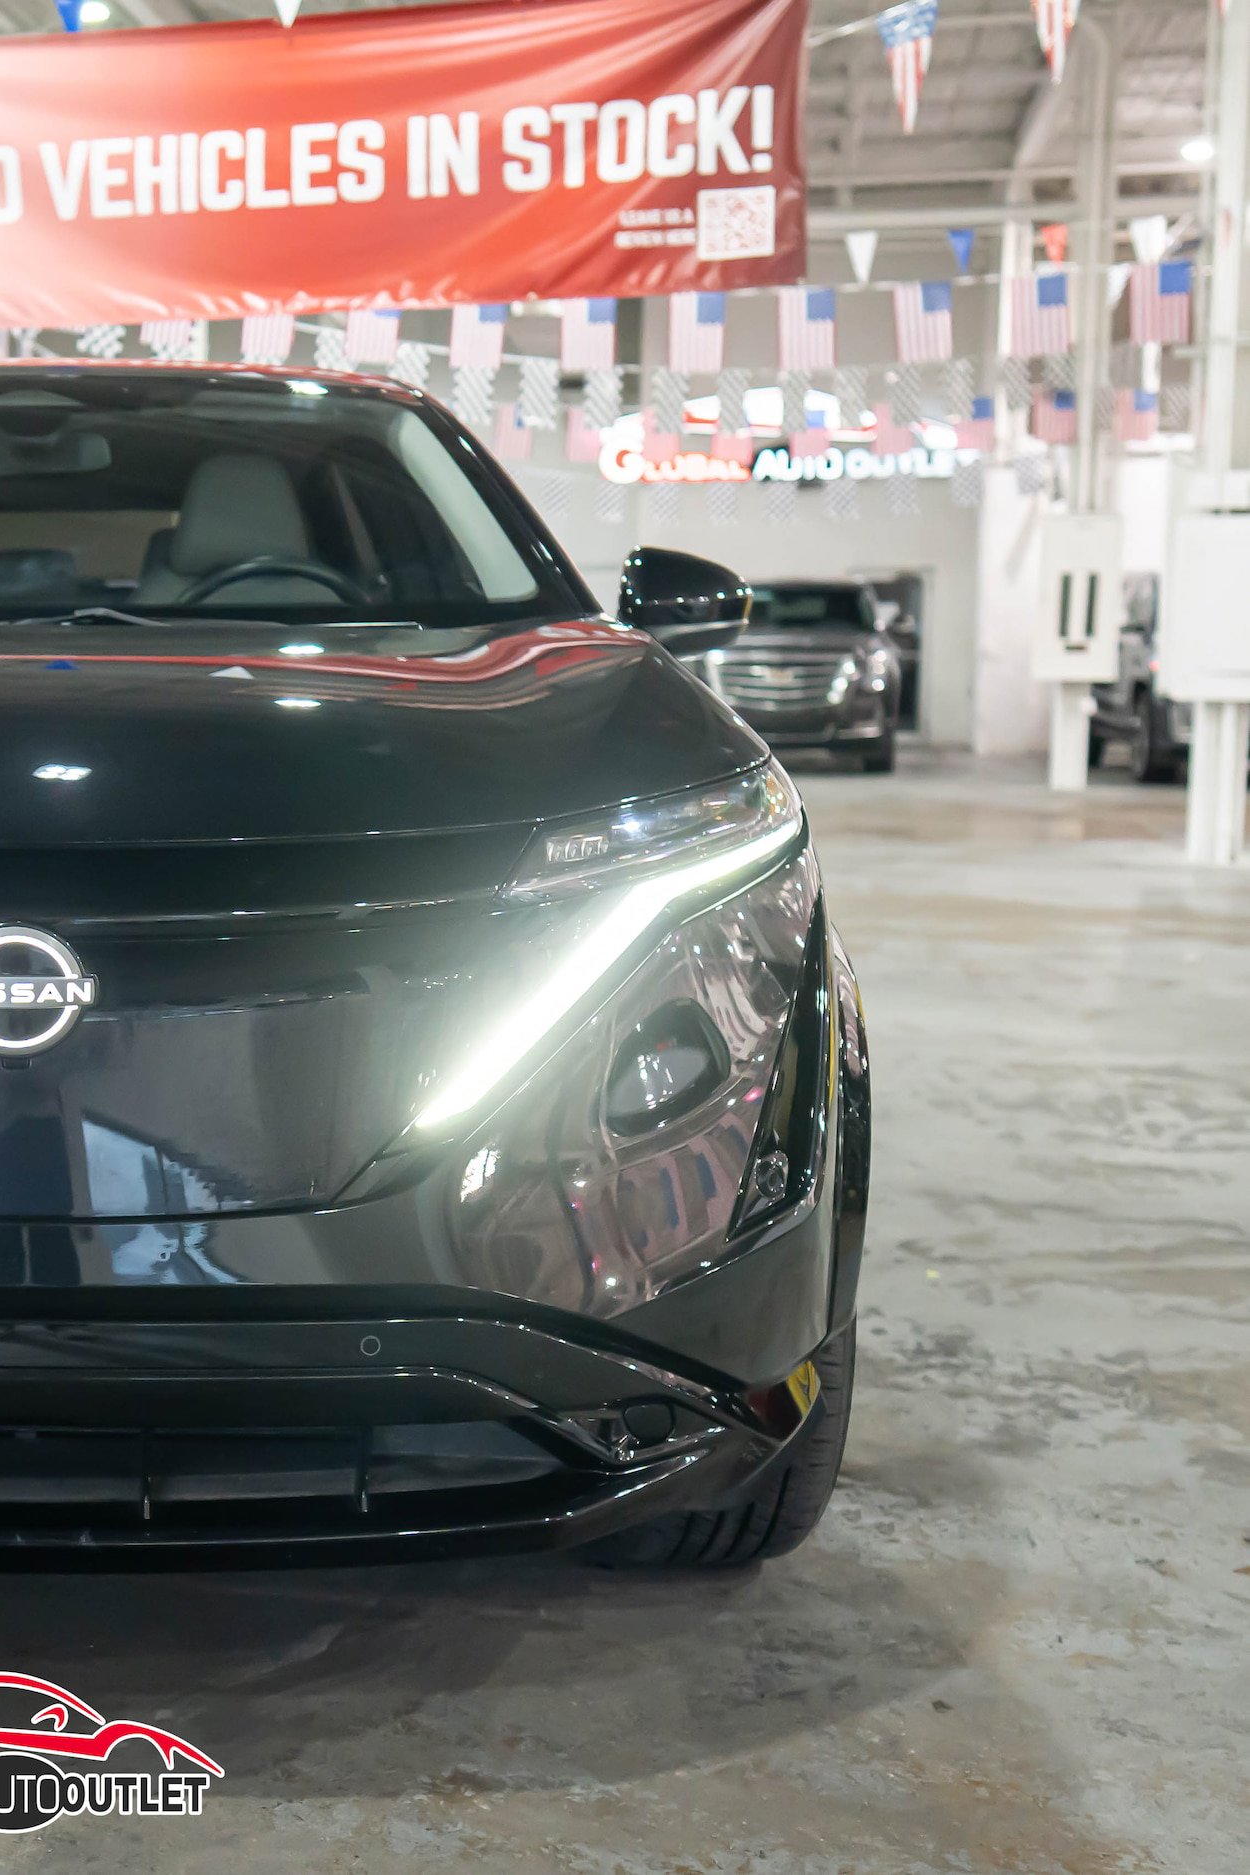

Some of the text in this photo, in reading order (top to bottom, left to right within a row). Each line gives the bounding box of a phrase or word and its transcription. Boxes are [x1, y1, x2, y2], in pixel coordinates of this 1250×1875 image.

[38, 118, 386, 222] VEHICLES
[407, 111, 480, 199] IN
[502, 84, 775, 193] STOCK!
